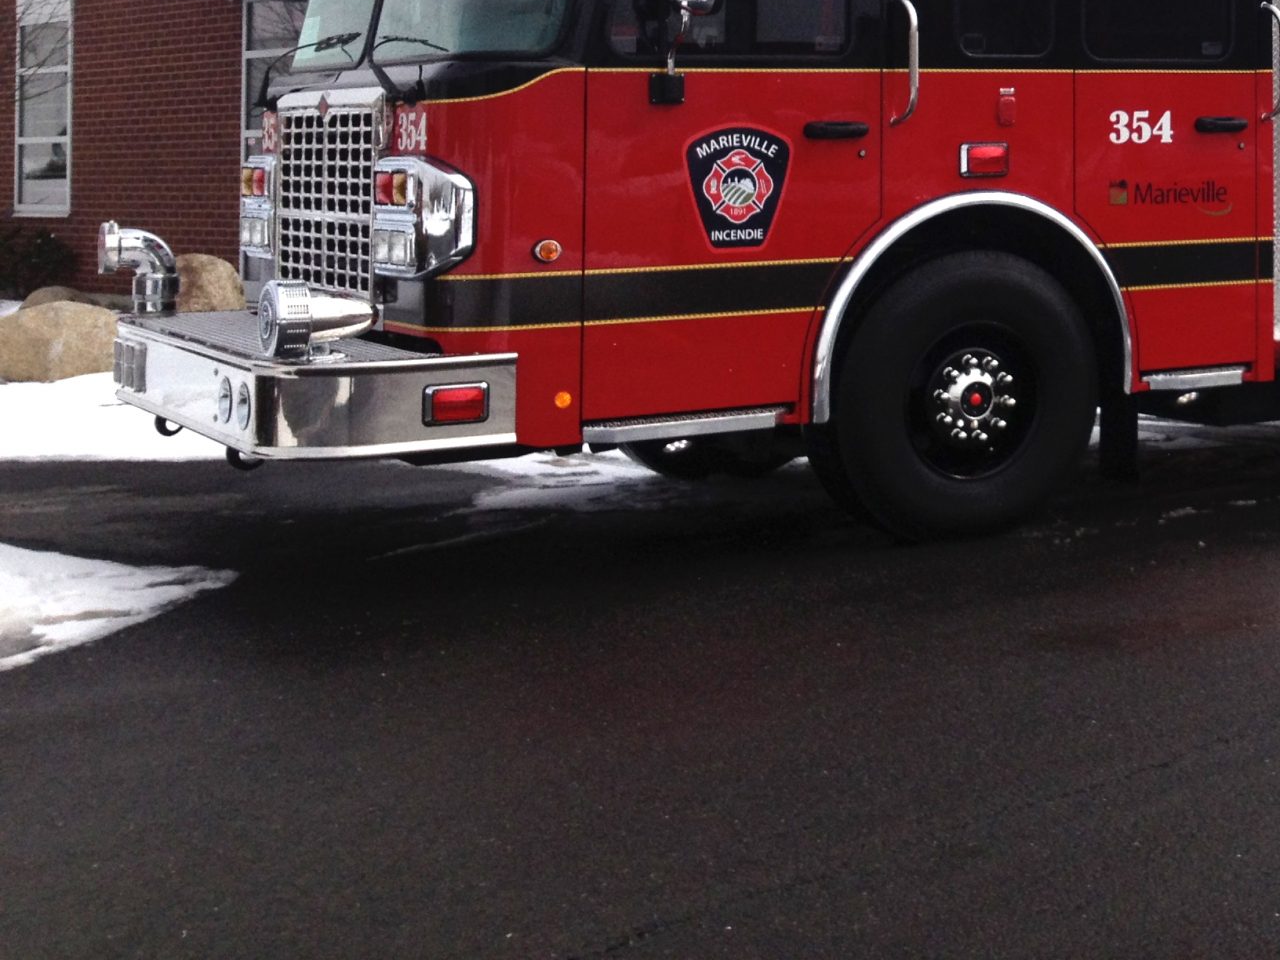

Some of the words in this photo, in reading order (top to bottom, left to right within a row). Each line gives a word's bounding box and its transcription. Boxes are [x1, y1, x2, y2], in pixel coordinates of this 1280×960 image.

[262, 117, 278, 149] 35
[398, 112, 427, 151] 354
[1109, 110, 1174, 144] 354
[696, 133, 779, 159] MARIEVILLE
[1134, 180, 1228, 205] Marieville
[711, 229, 764, 241] INCENDIE
